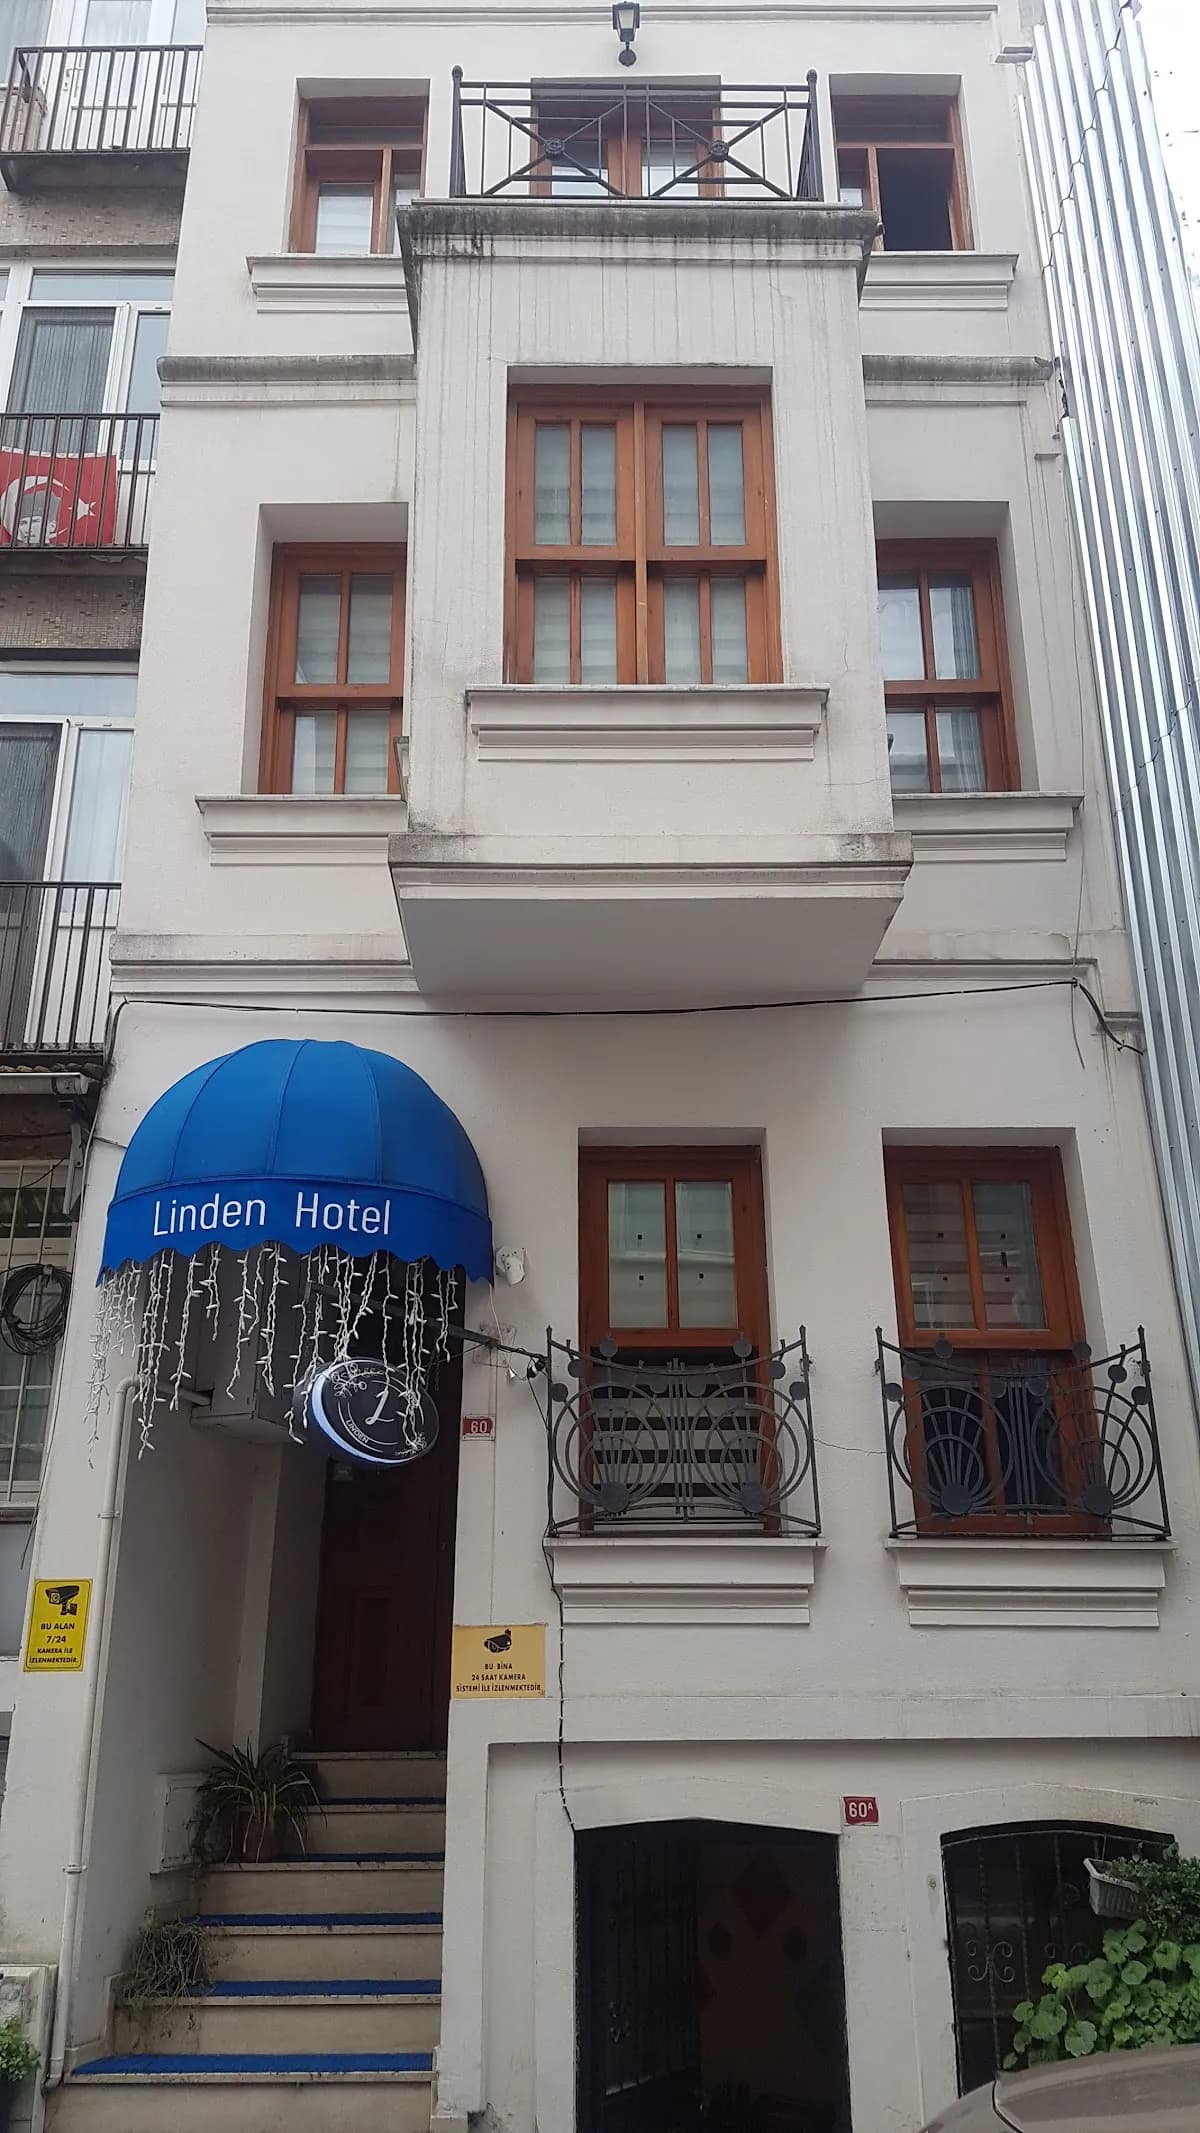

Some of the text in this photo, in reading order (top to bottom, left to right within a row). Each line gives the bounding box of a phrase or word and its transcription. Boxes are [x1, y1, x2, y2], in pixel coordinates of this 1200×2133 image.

[153, 1191, 391, 1236] Linden Hotel
[345, 1419, 369, 1444] LINDEN
[470, 1420, 488, 1433] 60
[497, 1662, 513, 1670] BİNA
[480, 1673, 498, 1681] SAAT
[499, 1673, 526, 1681] KAMERA
[456, 1683, 481, 1692] SİSTEMİ
[481, 1683, 491, 1692] İLE
